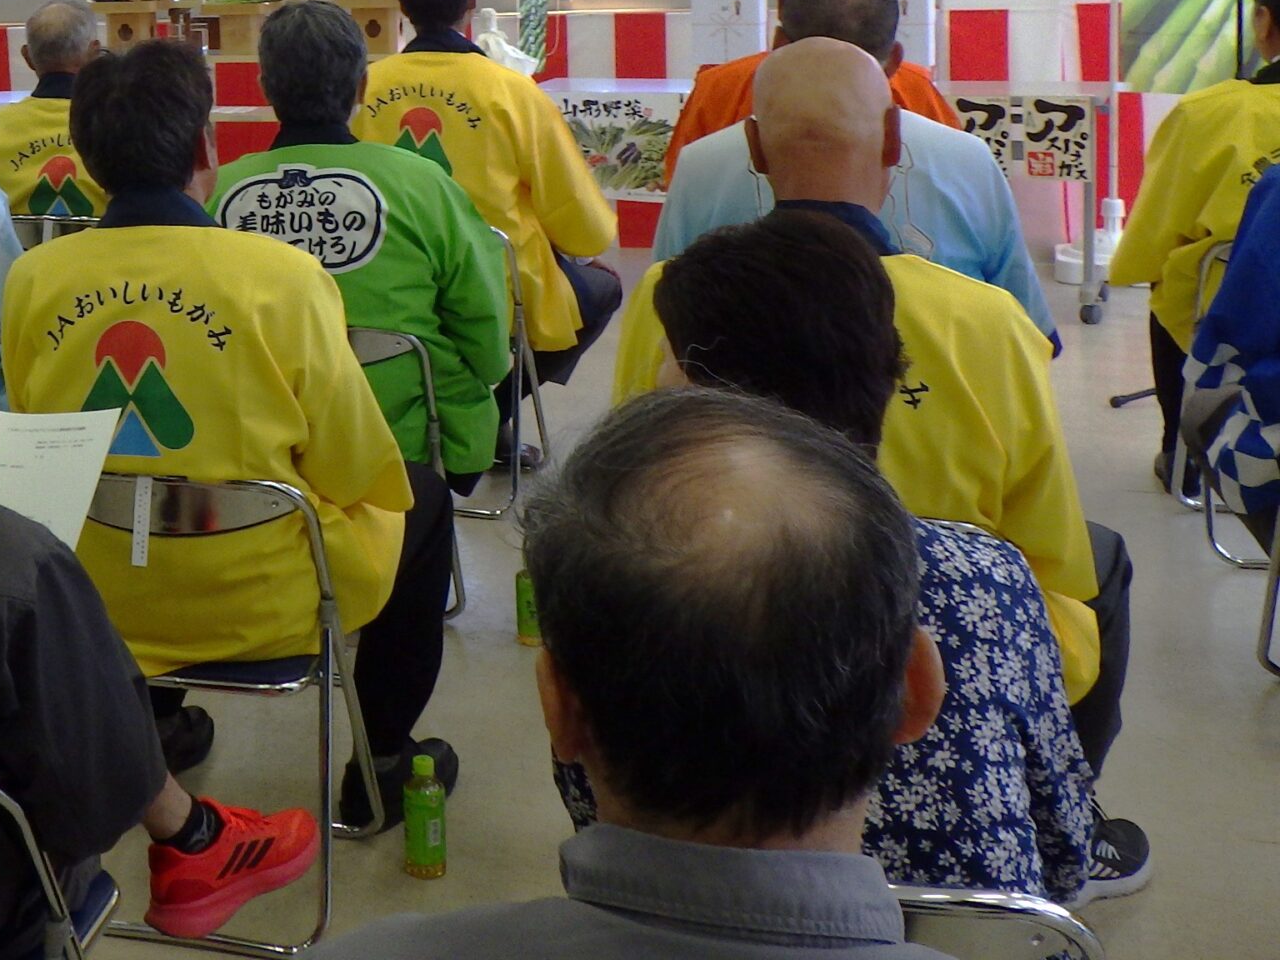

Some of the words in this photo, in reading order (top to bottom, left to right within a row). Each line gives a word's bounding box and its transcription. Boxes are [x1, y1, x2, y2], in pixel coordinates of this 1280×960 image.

[366, 83, 482, 129] JAおいしいもがみ
[256, 189, 336, 209] もがみの
[47, 281, 233, 351] JAおいしいもがみ
